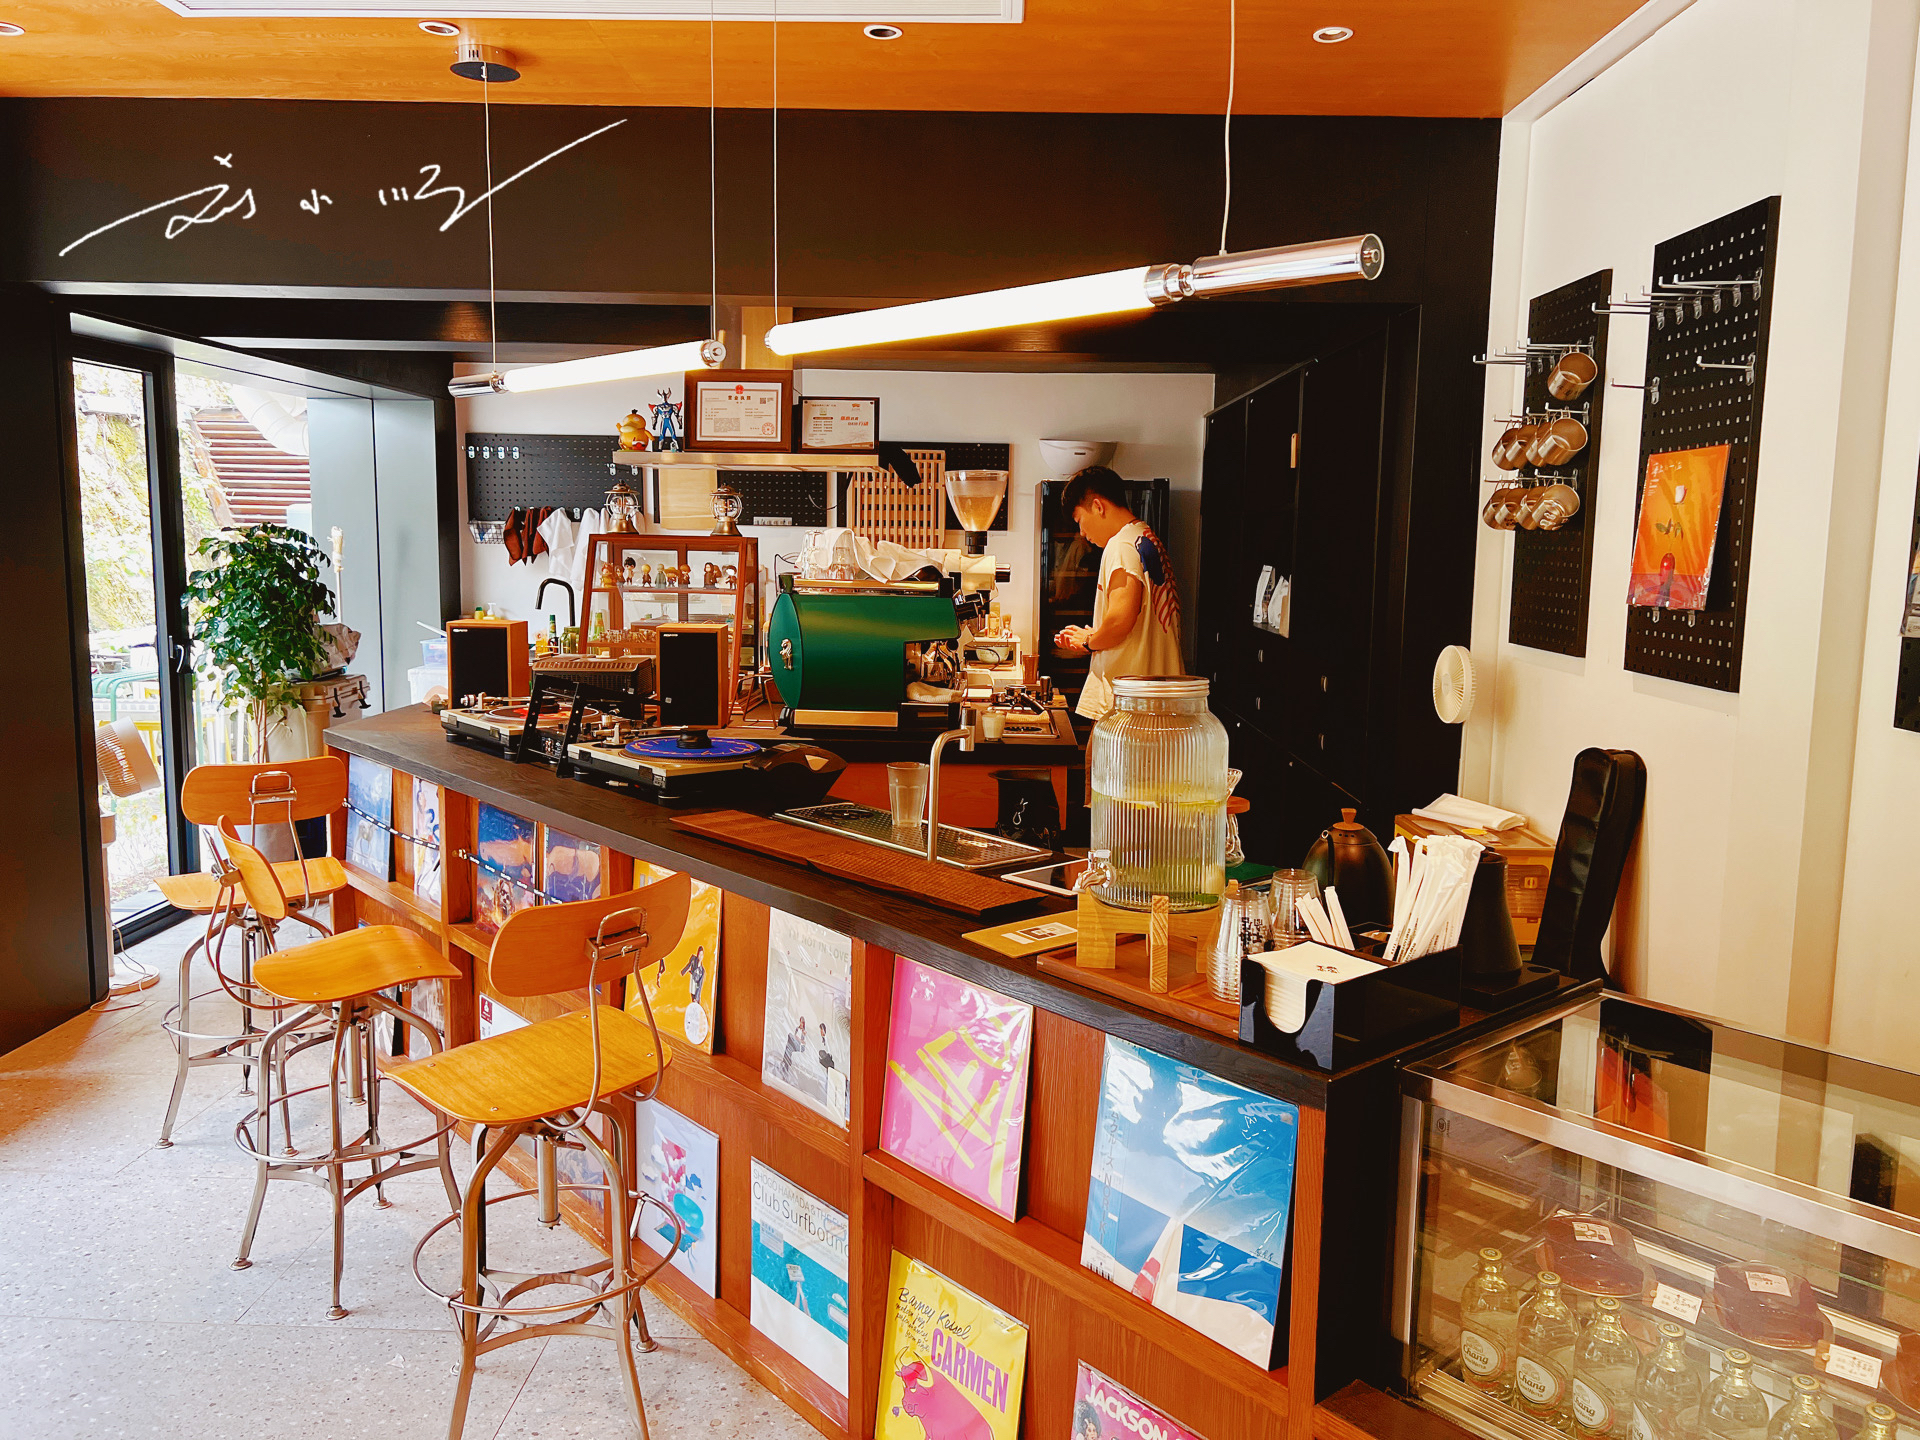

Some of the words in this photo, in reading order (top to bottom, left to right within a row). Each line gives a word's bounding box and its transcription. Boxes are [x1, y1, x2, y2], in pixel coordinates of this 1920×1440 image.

[753, 1168, 778, 1190] SHOGO
[778, 1184, 810, 1212] HAMADA
[753, 1181, 780, 1213] Club
[898, 1287, 936, 1324] Barney
[936, 1310, 972, 1341] Kessel
[931, 1327, 1009, 1413] CARMEN
[1462, 1344, 1489, 1365] Chang
[1518, 1371, 1546, 1393] Chang
